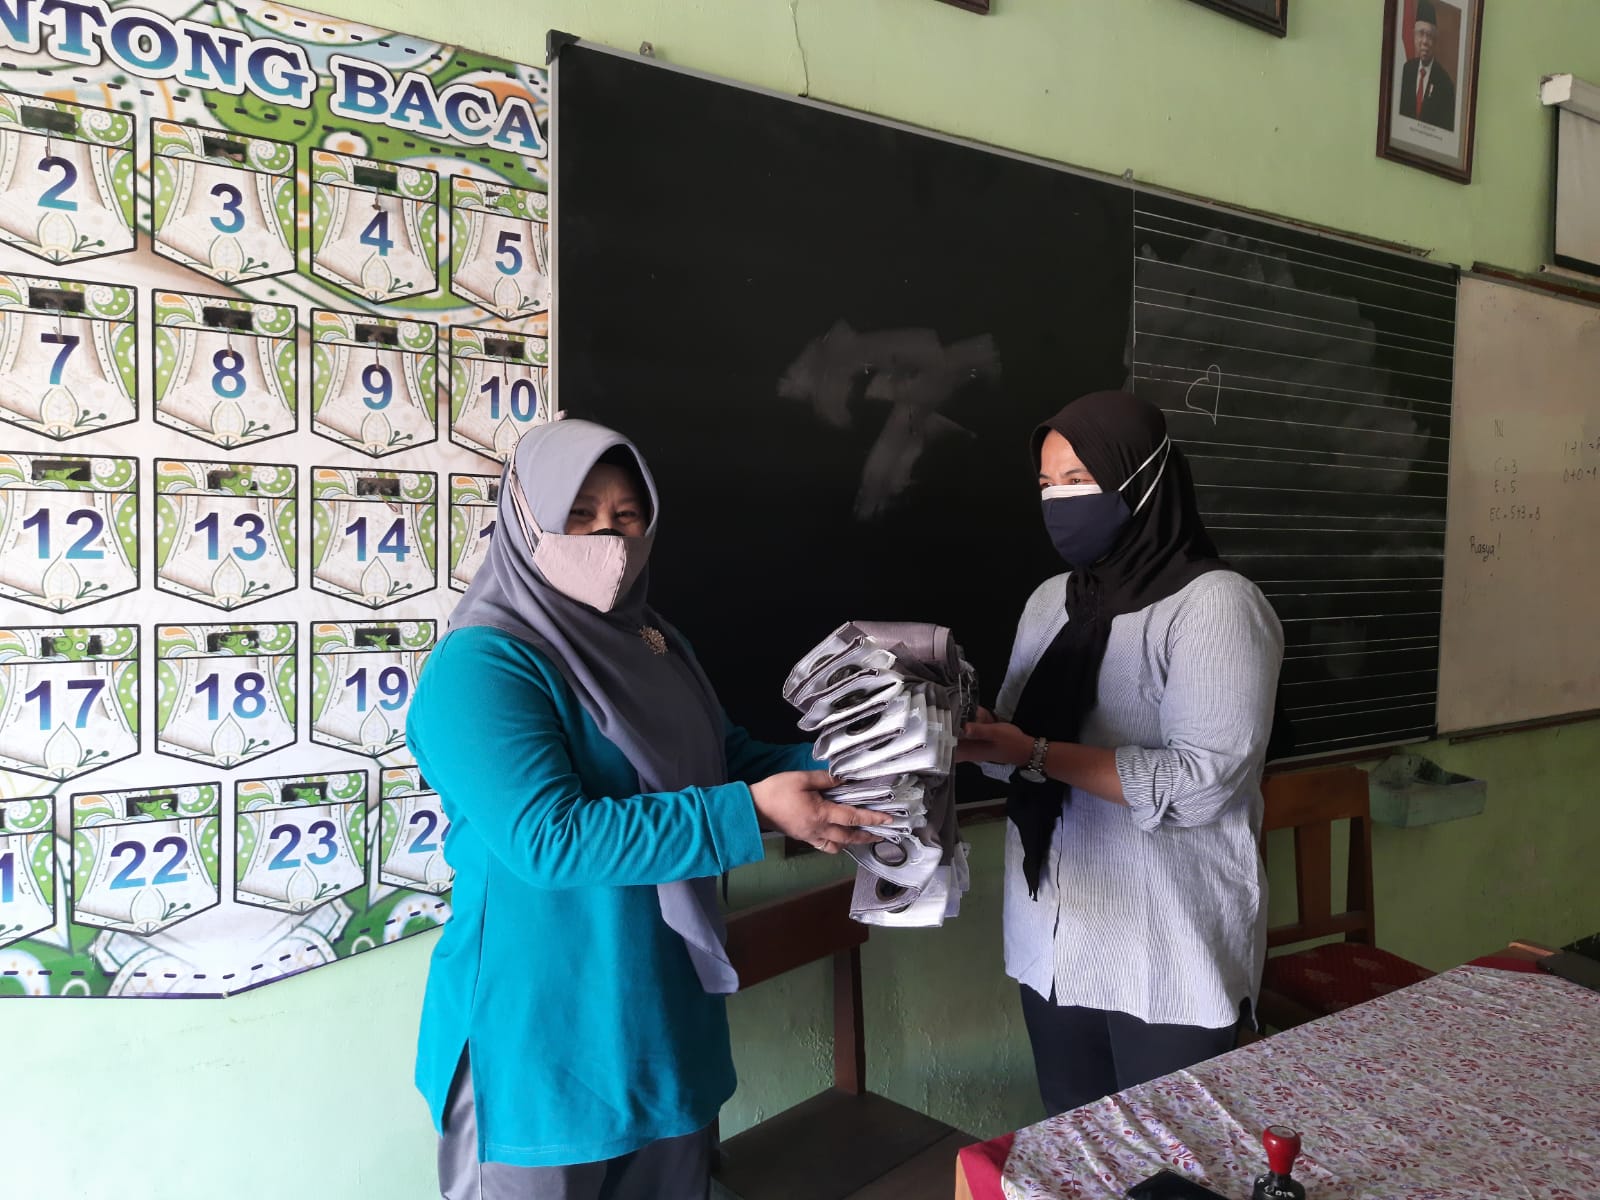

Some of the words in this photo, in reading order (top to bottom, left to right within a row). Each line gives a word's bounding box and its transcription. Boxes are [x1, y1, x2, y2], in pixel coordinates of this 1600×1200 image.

[337, 62, 543, 151] BACA
[37, 157, 79, 212] 2
[209, 183, 246, 234] 3
[359, 211, 395, 257] 4
[494, 232, 523, 276] 5
[40, 333, 80, 385] 7
[211, 349, 247, 399] 8
[362, 365, 393, 410] 9
[480, 376, 538, 422] 10
[22, 508, 105, 560] 12
[193, 512, 268, 562] 13
[345, 517, 411, 562] 14
[24, 678, 106, 731] 17
[194, 671, 267, 720] 18
[345, 666, 409, 712] 19
[109, 836, 189, 890] 22
[268, 820, 339, 871] 23
